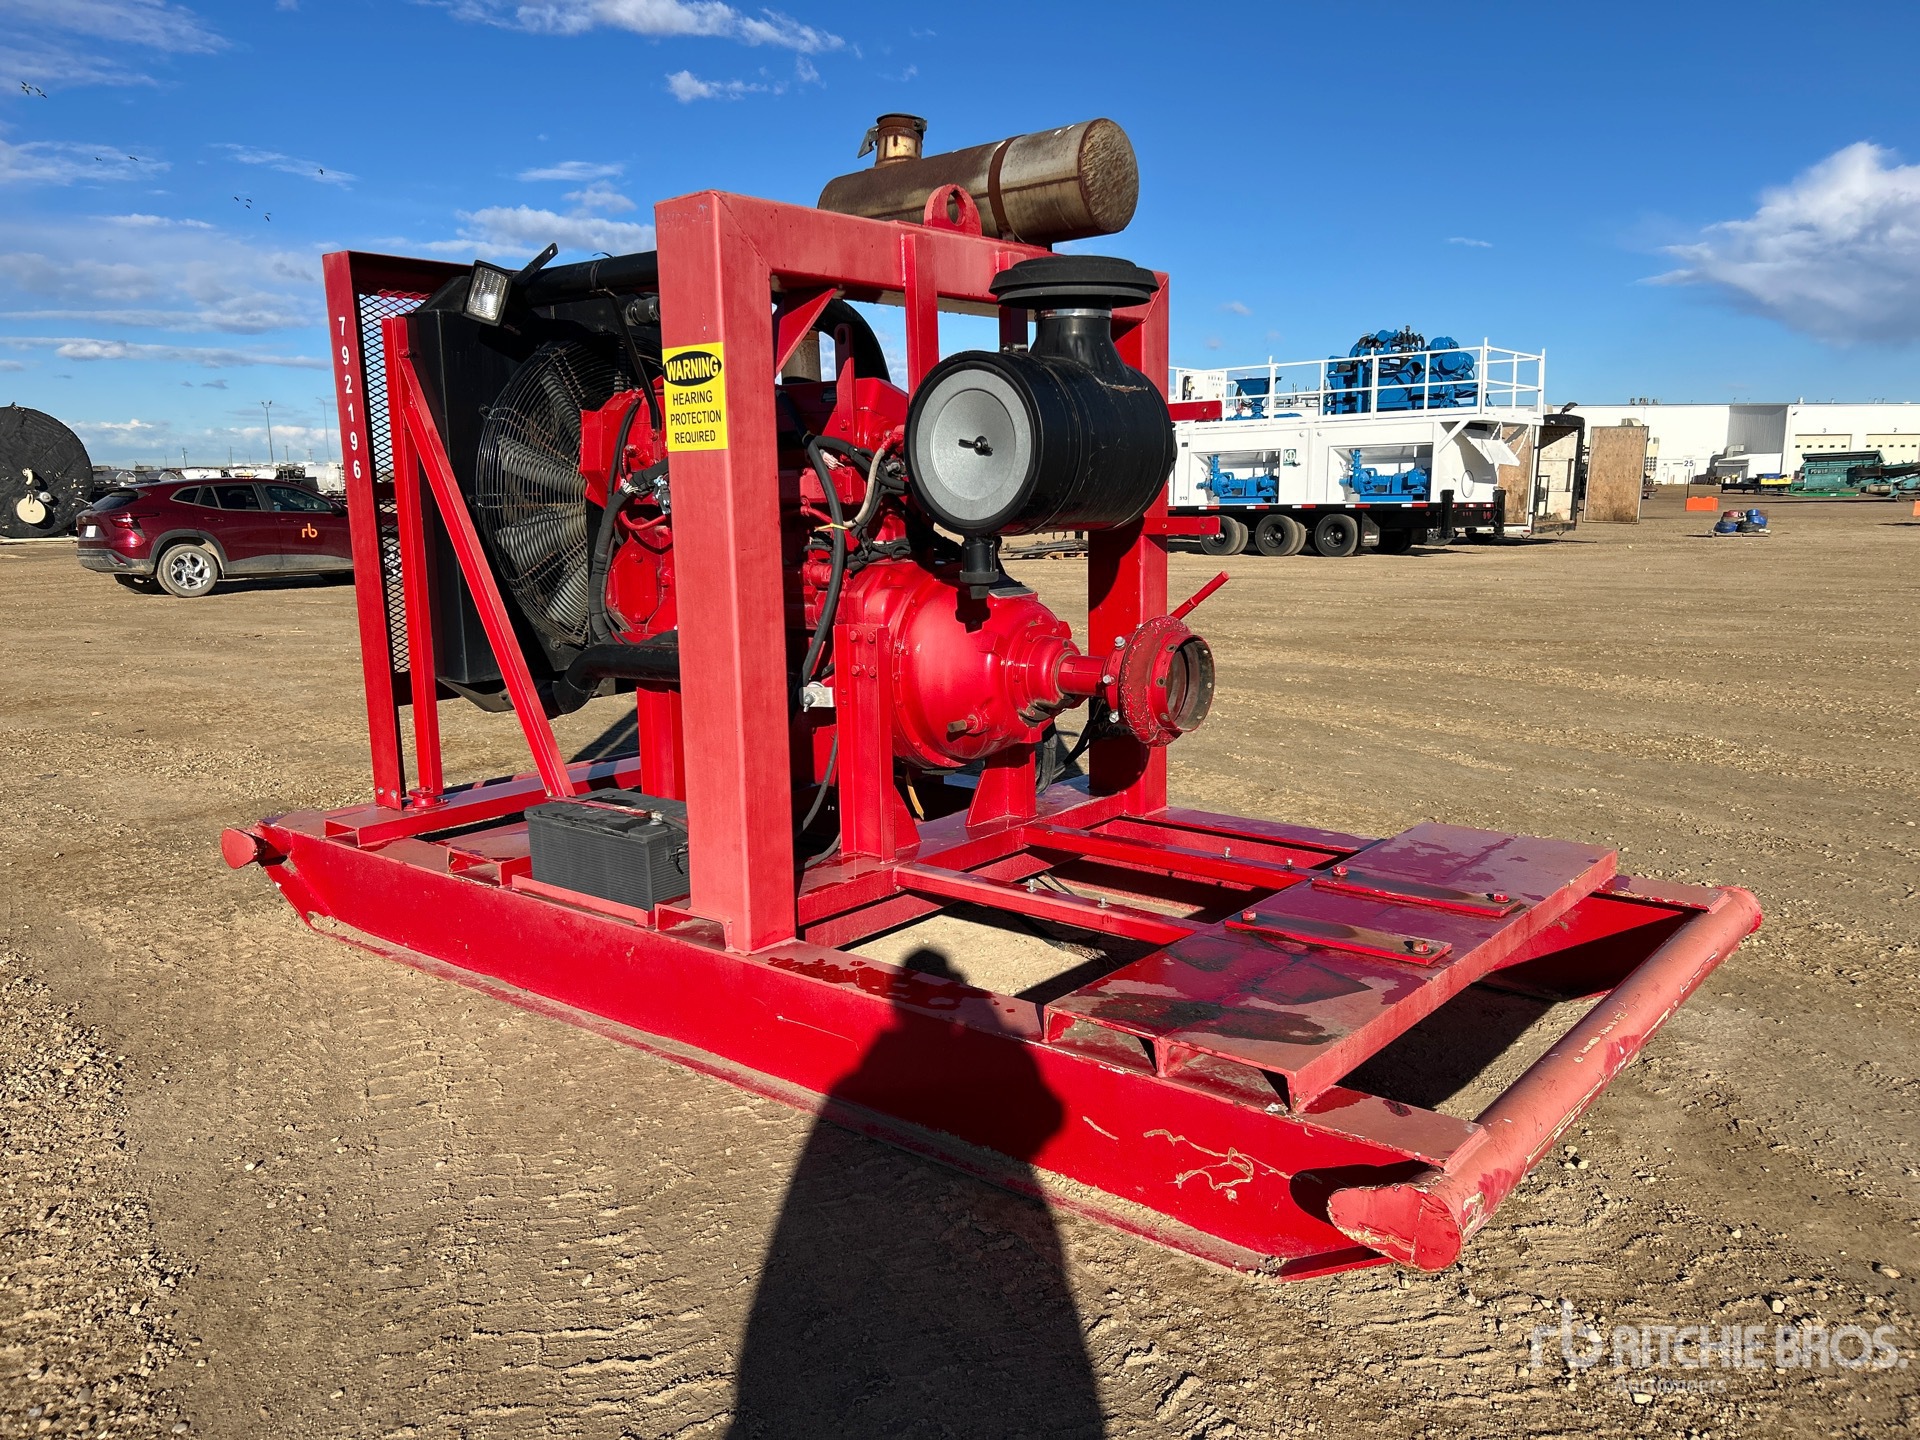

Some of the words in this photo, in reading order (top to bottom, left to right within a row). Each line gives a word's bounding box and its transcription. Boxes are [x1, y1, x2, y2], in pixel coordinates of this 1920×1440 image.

[666, 355, 719, 382] WARNING
[338, 316, 361, 479] 792196
[672, 390, 713, 406] HEARING
[670, 409, 722, 426] PROTECTION
[674, 430, 716, 444] REQUIRED
[1683, 459, 1694, 467] 25
[301, 523, 318, 538] rb
